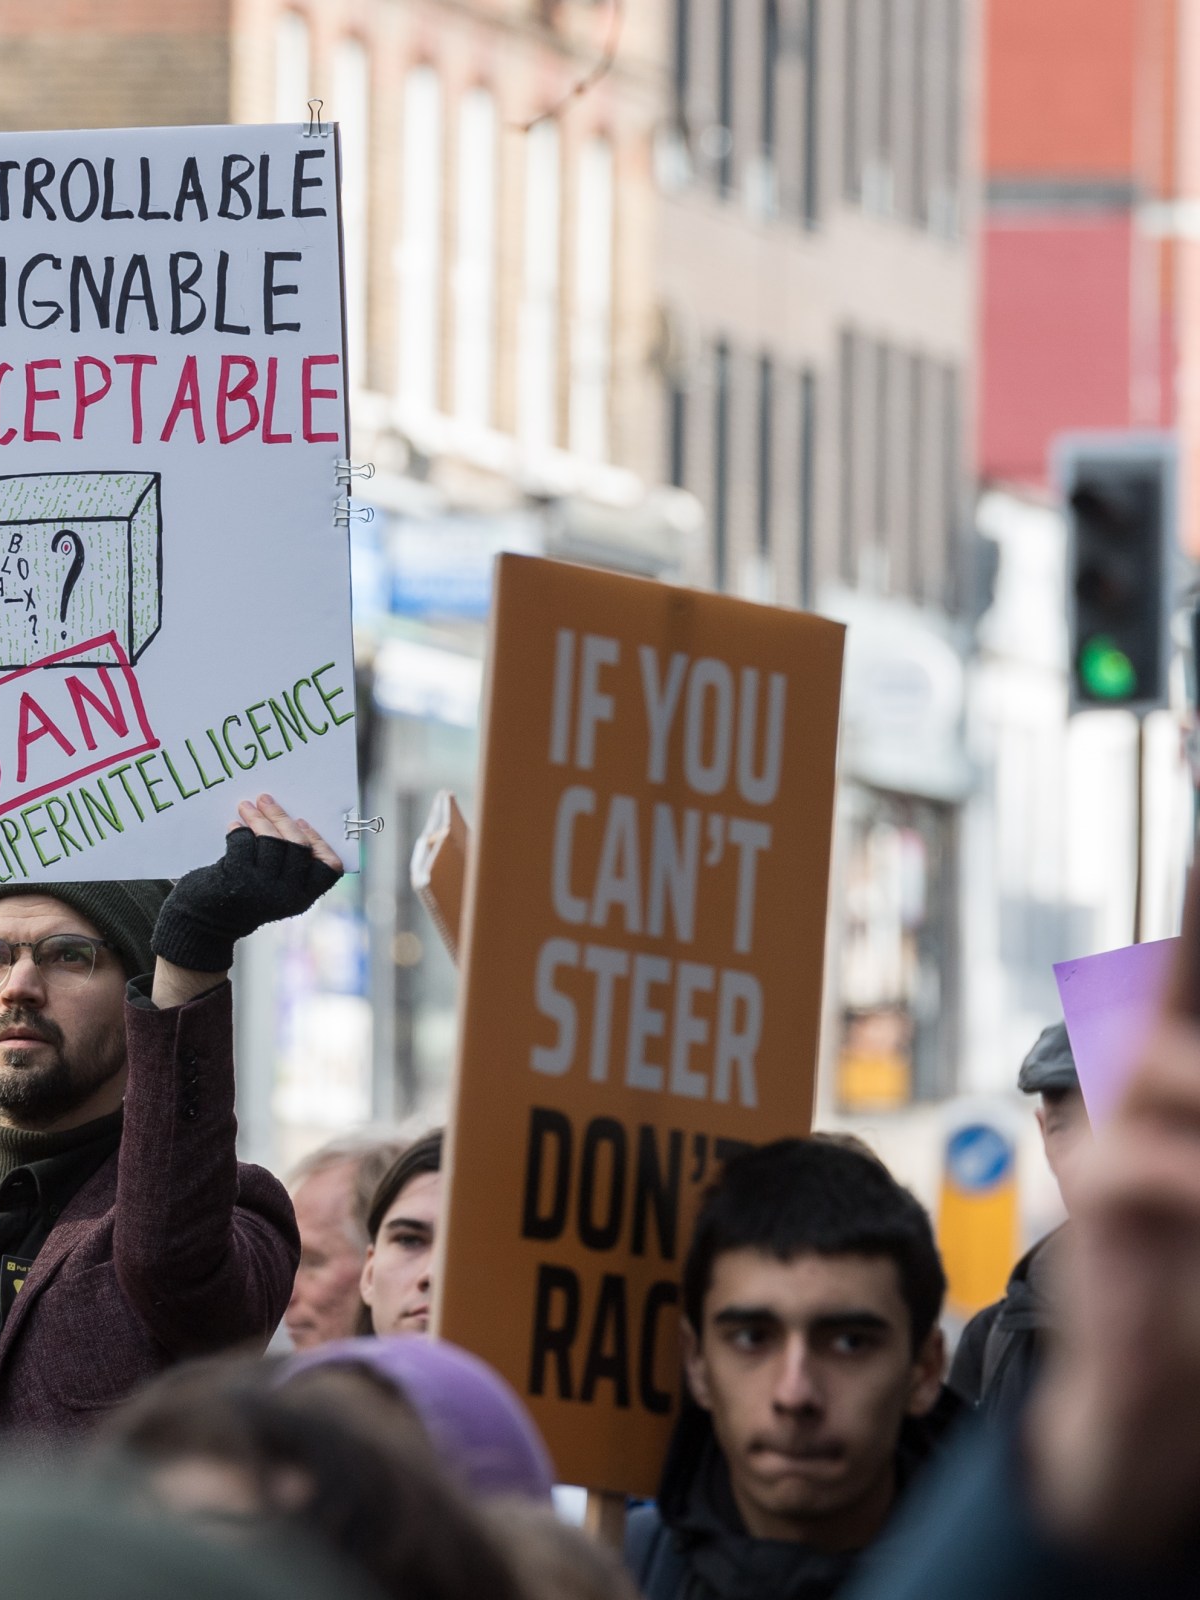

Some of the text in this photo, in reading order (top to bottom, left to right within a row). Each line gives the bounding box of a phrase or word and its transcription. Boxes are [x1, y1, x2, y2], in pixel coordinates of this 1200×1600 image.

[549, 627, 787, 806] IF YOU
[551, 785, 771, 955] CAN'T
[529, 936, 764, 1109] STEER
[521, 1105, 757, 1261] DON'
[528, 1263, 684, 1417] RAC
